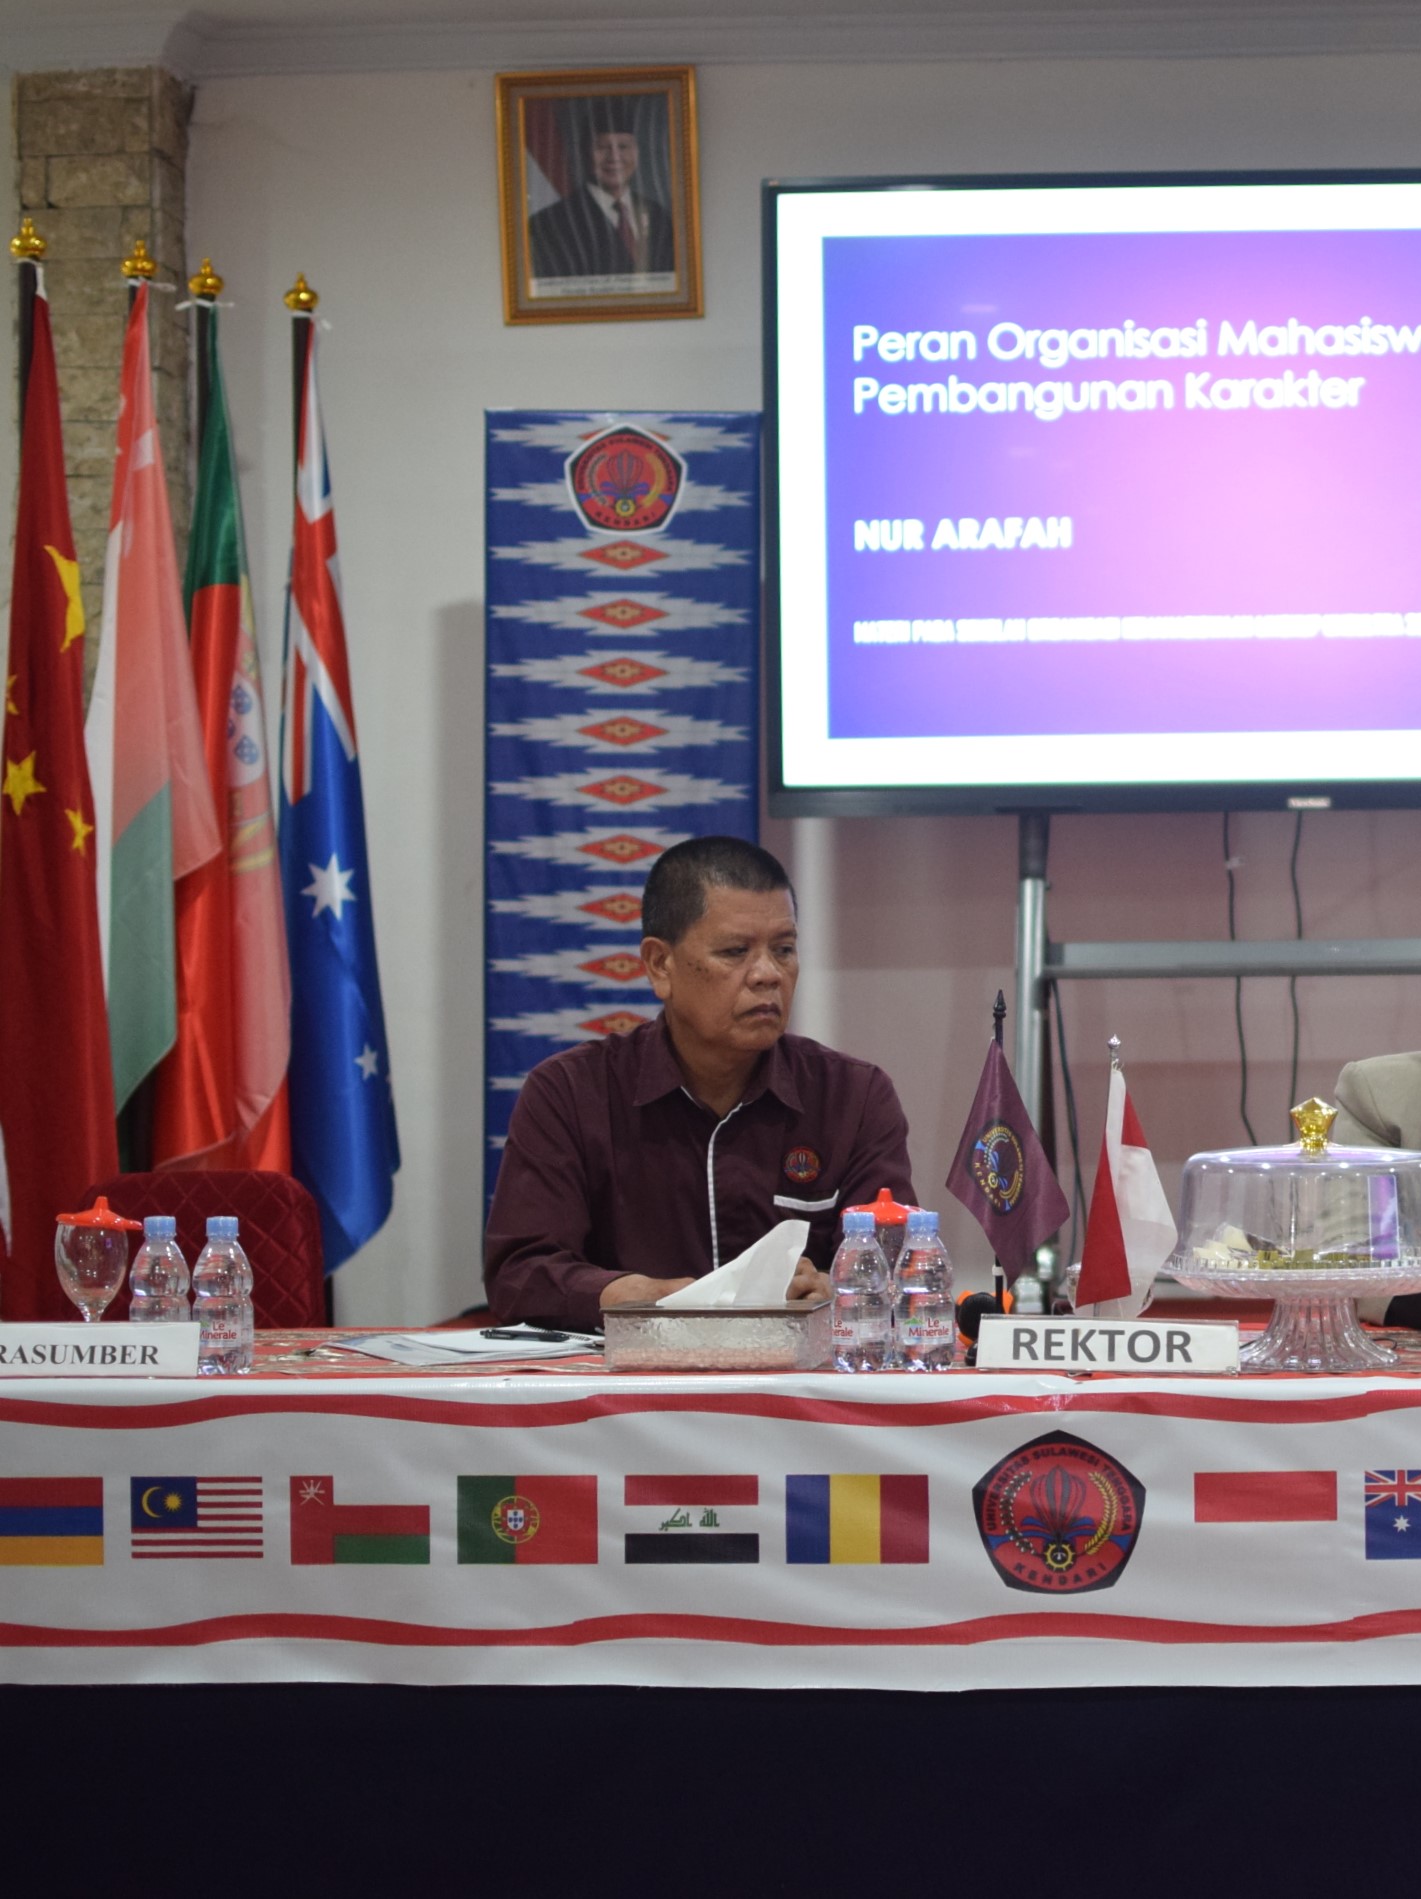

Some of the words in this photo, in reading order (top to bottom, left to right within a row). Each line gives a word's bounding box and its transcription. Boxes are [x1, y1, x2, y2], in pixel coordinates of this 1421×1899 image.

[852, 324, 977, 362] Peran
[986, 318, 1208, 368] Organisasi
[852, 374, 1175, 421] Pembangunan
[1184, 369, 1367, 410] Karakter
[853, 518, 924, 552] NUR
[930, 516, 1072, 550] ARAFAH
[908, 1327, 949, 1337] Minerale
[927, 1317, 940, 1328] Le
[1012, 1327, 1193, 1363] REKTOR
[1013, 1562, 1107, 1586] KENDARI
